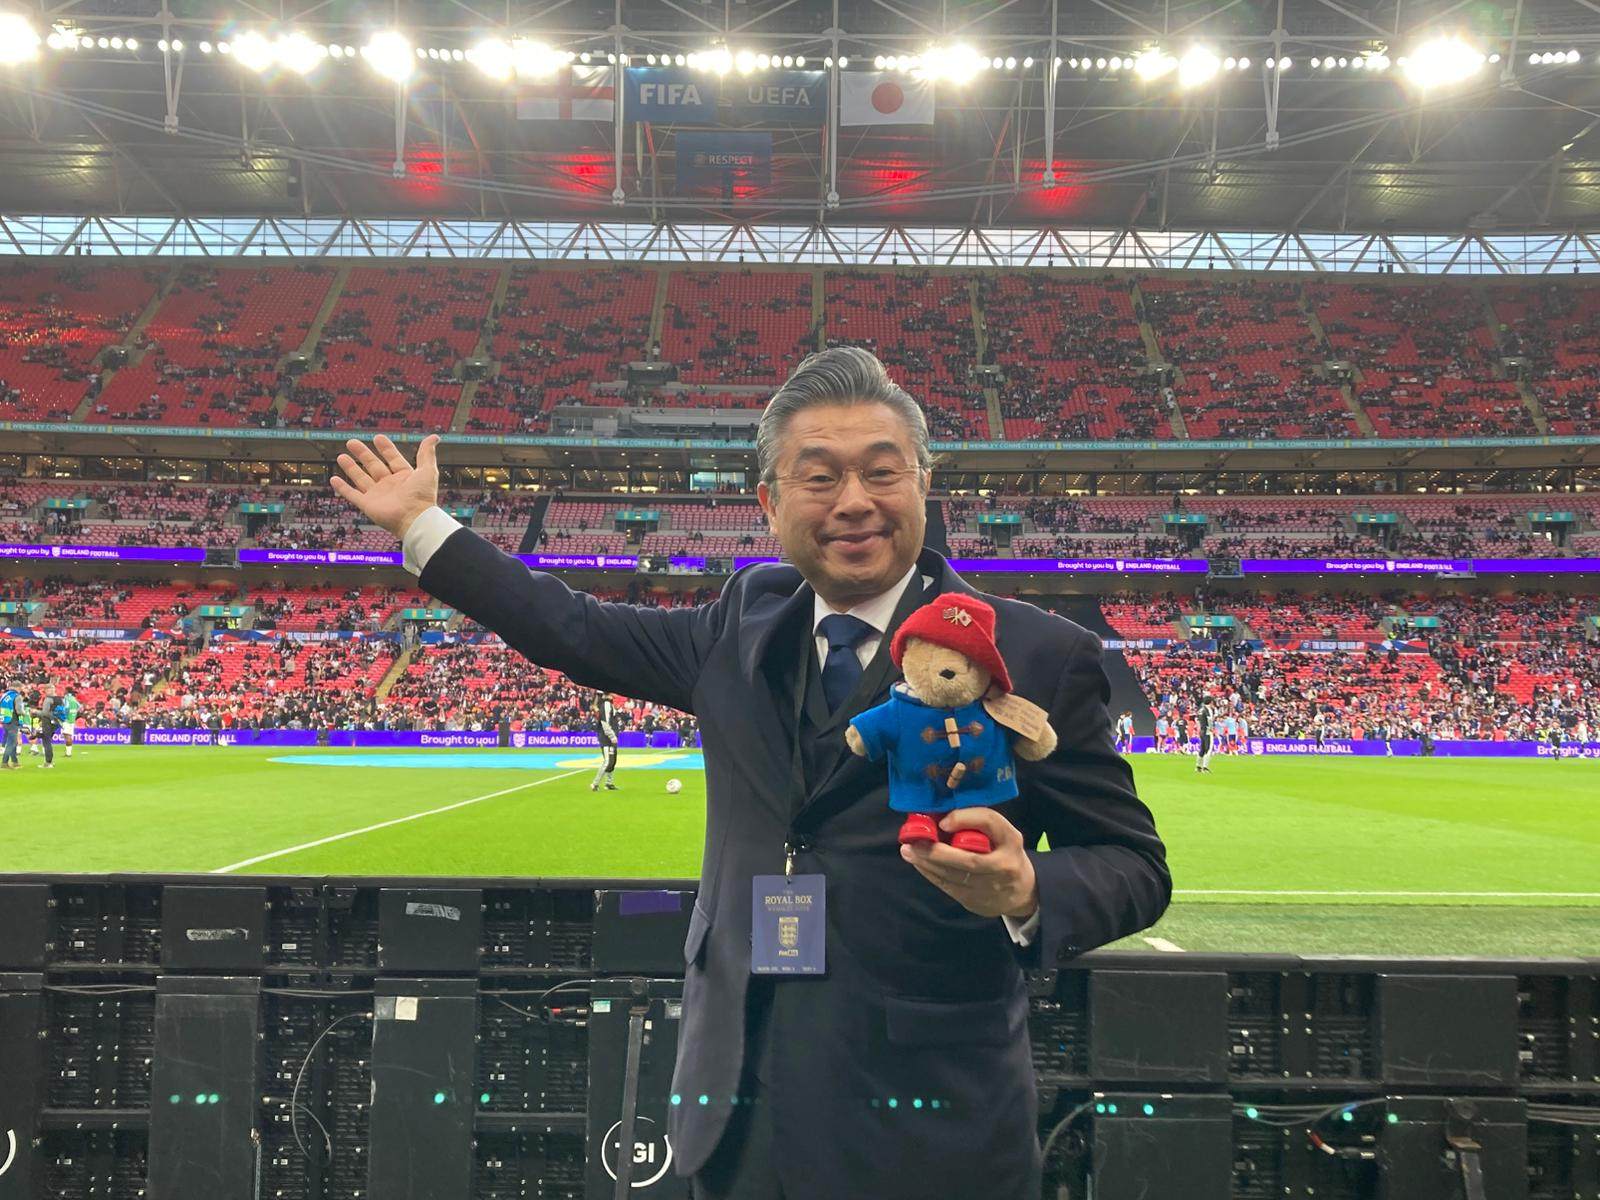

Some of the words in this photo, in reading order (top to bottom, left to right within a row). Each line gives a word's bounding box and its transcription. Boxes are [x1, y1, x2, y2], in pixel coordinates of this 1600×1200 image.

[640, 83, 702, 105] FIFA
[748, 86, 810, 105] UEFA
[709, 155, 753, 165] RESPECT
[18, 547, 26, 555] to
[40, 547, 50, 556] by
[268, 552, 295, 561] Brought
[317, 553, 326, 561] by
[539, 557, 565, 565] Brought
[586, 558, 595, 566] by
[1105, 562, 1114, 570] by
[1376, 562, 1384, 570] by
[85, 732, 95, 741] to
[96, 734, 116, 744] you
[117, 731, 131, 743] by
[149, 734, 190, 742] ENGLAND
[421, 734, 462, 746] Brought
[464, 735, 474, 744] to
[476, 737, 495, 746] you
[528, 736, 568, 744] ENGLAND
[570, 736, 600, 745] FOOTB
[1266, 743, 1307, 752] ENGLAND
[764, 895, 794, 905] ROYAL
[795, 895, 812, 904] BOX
